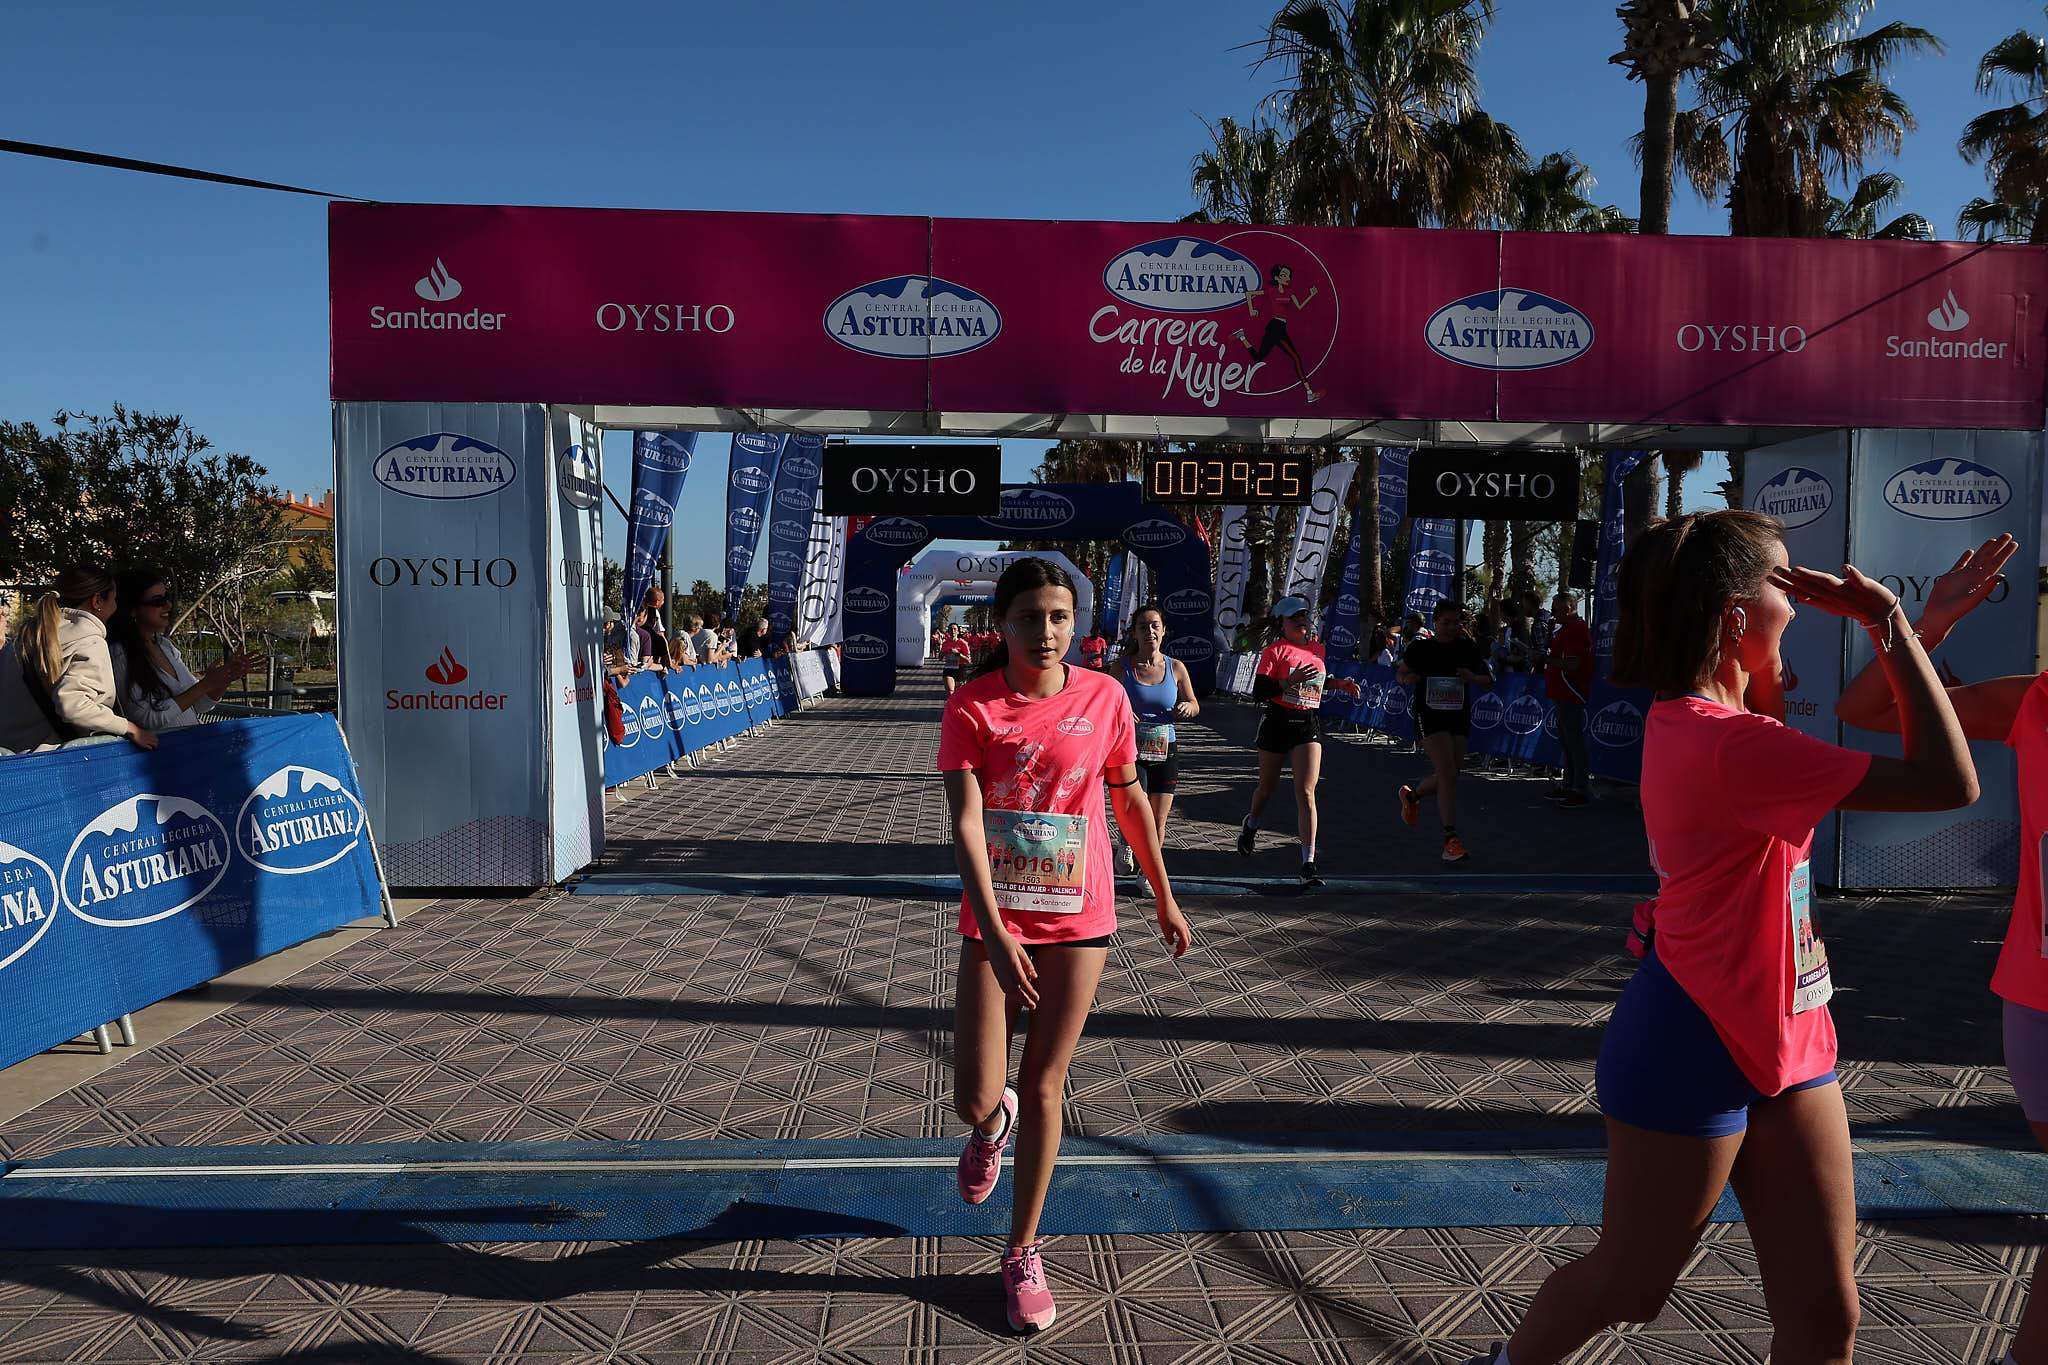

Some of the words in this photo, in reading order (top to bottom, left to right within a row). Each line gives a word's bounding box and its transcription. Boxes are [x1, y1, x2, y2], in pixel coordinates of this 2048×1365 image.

[1115, 262, 1249, 294] ASTURIANA
[1140, 261, 1192, 271] CENTRAL
[1195, 263, 1245, 272] LECHERA
[370, 306, 506, 331] Santander
[596, 303, 735, 333] OYSHO
[865, 303, 921, 312] CENTRAL
[837, 304, 988, 337] ASTURIANA
[1088, 304, 1219, 348] Carrera
[1437, 317, 1581, 349] ASTURIANA
[1464, 315, 1517, 325] CENTRAL
[1522, 317, 1576, 326] LECHERA
[1677, 324, 1807, 353] OYSHO
[1886, 335, 2007, 360] Santander
[1119, 346, 1144, 374] de
[1149, 346, 1167, 375] la
[1162, 343, 1267, 408] Mujer
[383, 456, 506, 484] ASTURIANA
[405, 455, 450, 463] CENTRAL
[455, 456, 502, 464] LECHERA
[851, 467, 976, 494] OYSHO
[1154, 461, 1300, 497] 00:39:25
[1436, 471, 1555, 499] OYSHO
[1912, 478, 1952, 486] CENTRAL
[1956, 479, 1999, 487] LECHERA
[1759, 493, 1828, 516] ASTURIANA
[1892, 480, 2003, 505] ASTURIANA
[1000, 505, 1069, 520] STURIANA
[870, 526, 924, 541] ASTURIANA
[1128, 529, 1182, 543] ASTURIANA
[369, 557, 517, 588] OYSHO
[956, 555, 1014, 573] OYSH
[1878, 574, 2010, 604] OYO
[386, 689, 508, 712] Santander
[263, 802, 305, 819] CENTRAL
[103, 834, 157, 860] CENTRAL
[160, 823, 213, 845] LECHERA
[250, 808, 354, 857] ASTURIANA
[78, 839, 222, 908] ASTURIANA
[1014, 855, 1054, 873] 016
[1008, 884, 1018, 892] DE
[1018, 885, 1026, 893] LA
[1027, 885, 1047, 893] MUJER
[1051, 886, 1078, 895] VALENCIA
[1022, 875, 1041, 884] 1503
[1040, 898, 1072, 907] Santander
